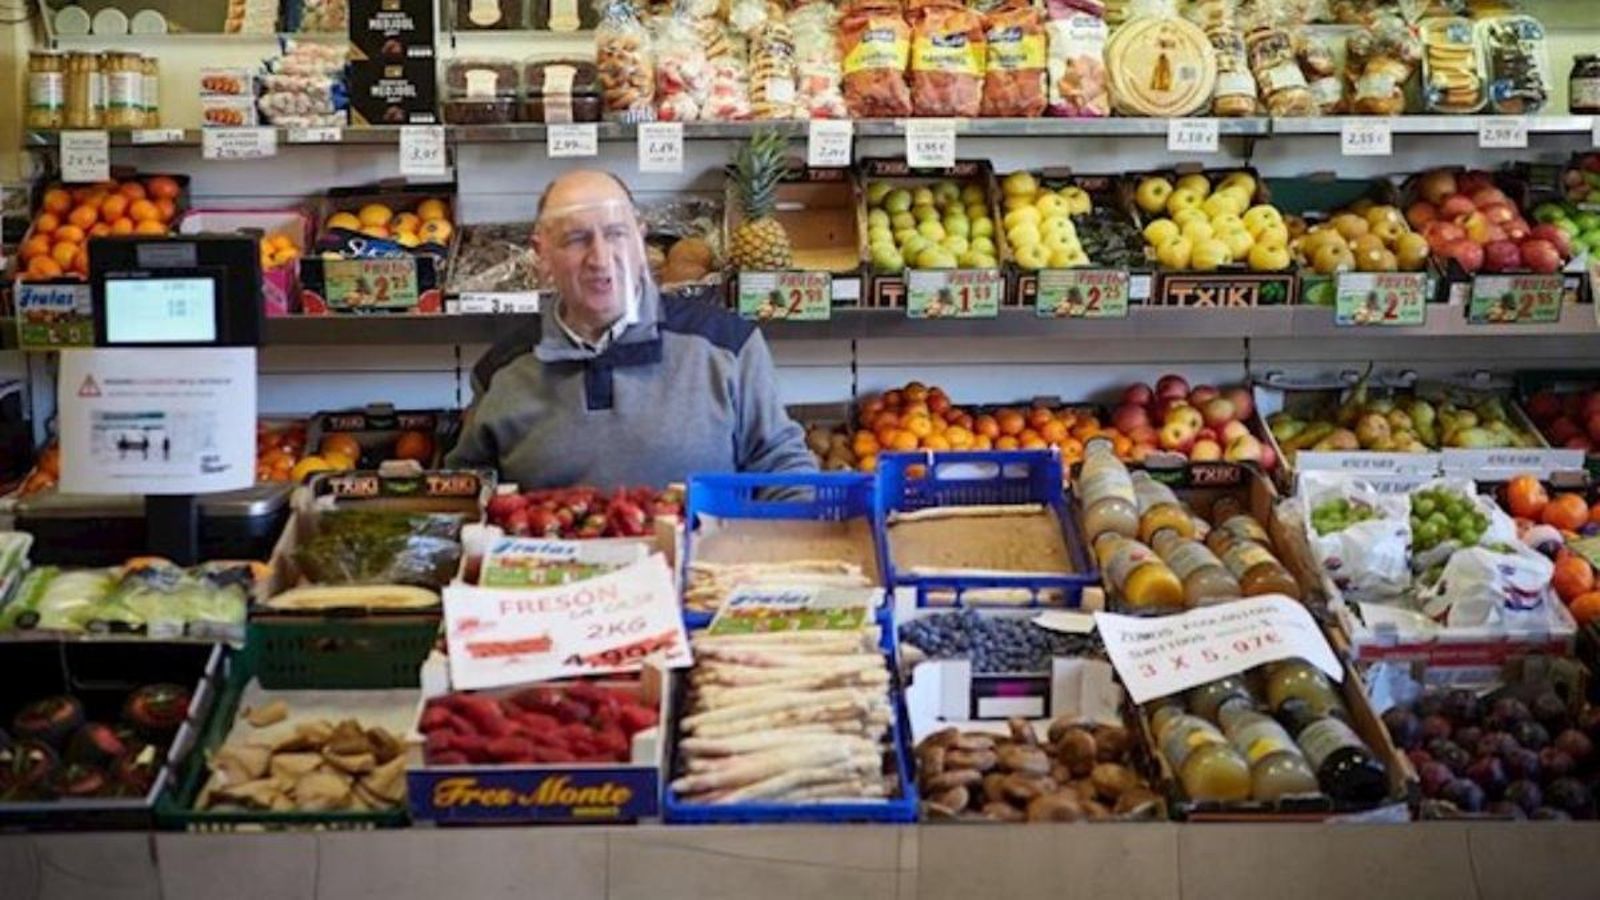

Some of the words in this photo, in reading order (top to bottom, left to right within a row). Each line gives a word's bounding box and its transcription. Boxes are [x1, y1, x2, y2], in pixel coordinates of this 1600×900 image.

[788, 288, 804, 314] 2
[959, 286, 971, 313] 1
[1086, 286, 1102, 311] 2
[1169, 288, 1258, 308] TXIKI
[1384, 291, 1399, 320] 2
[1518, 292, 1537, 318] 2
[329, 477, 379, 496] TXIKI
[426, 475, 478, 495] TXIKI
[517, 774, 633, 807] Monte
